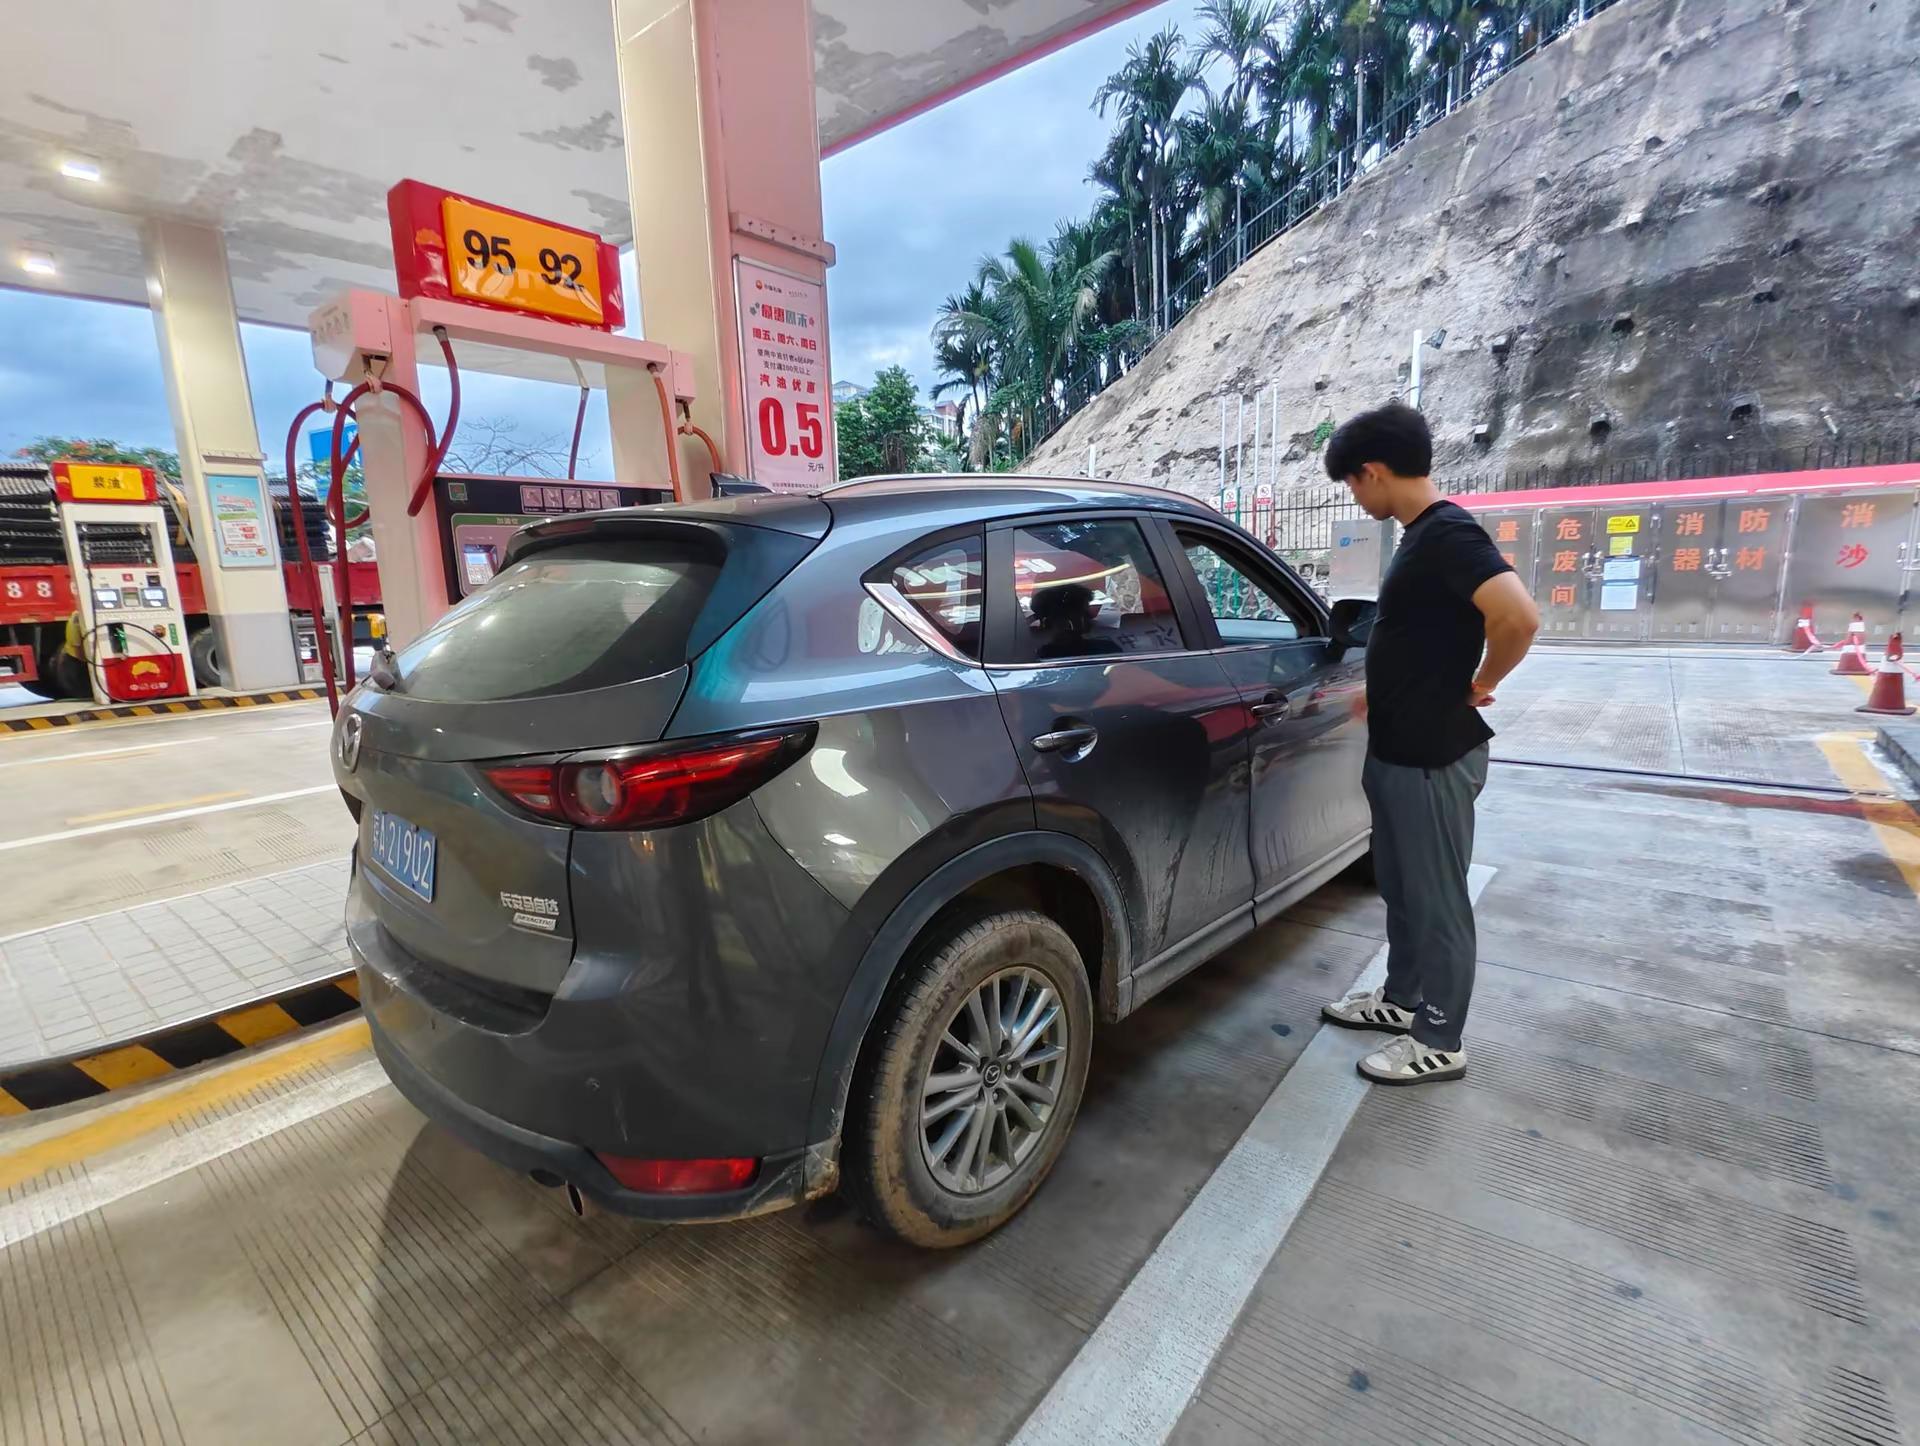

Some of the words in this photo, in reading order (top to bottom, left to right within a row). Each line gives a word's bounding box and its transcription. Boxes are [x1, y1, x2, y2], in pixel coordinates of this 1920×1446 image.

[463, 229, 516, 275] 95
[538, 248, 584, 292] 92
[759, 373, 816, 394] 汽油优惠
[758, 397, 823, 459] 0.5
[807, 462, 824, 472] 元/升
[1550, 518, 1582, 607] 危废间
